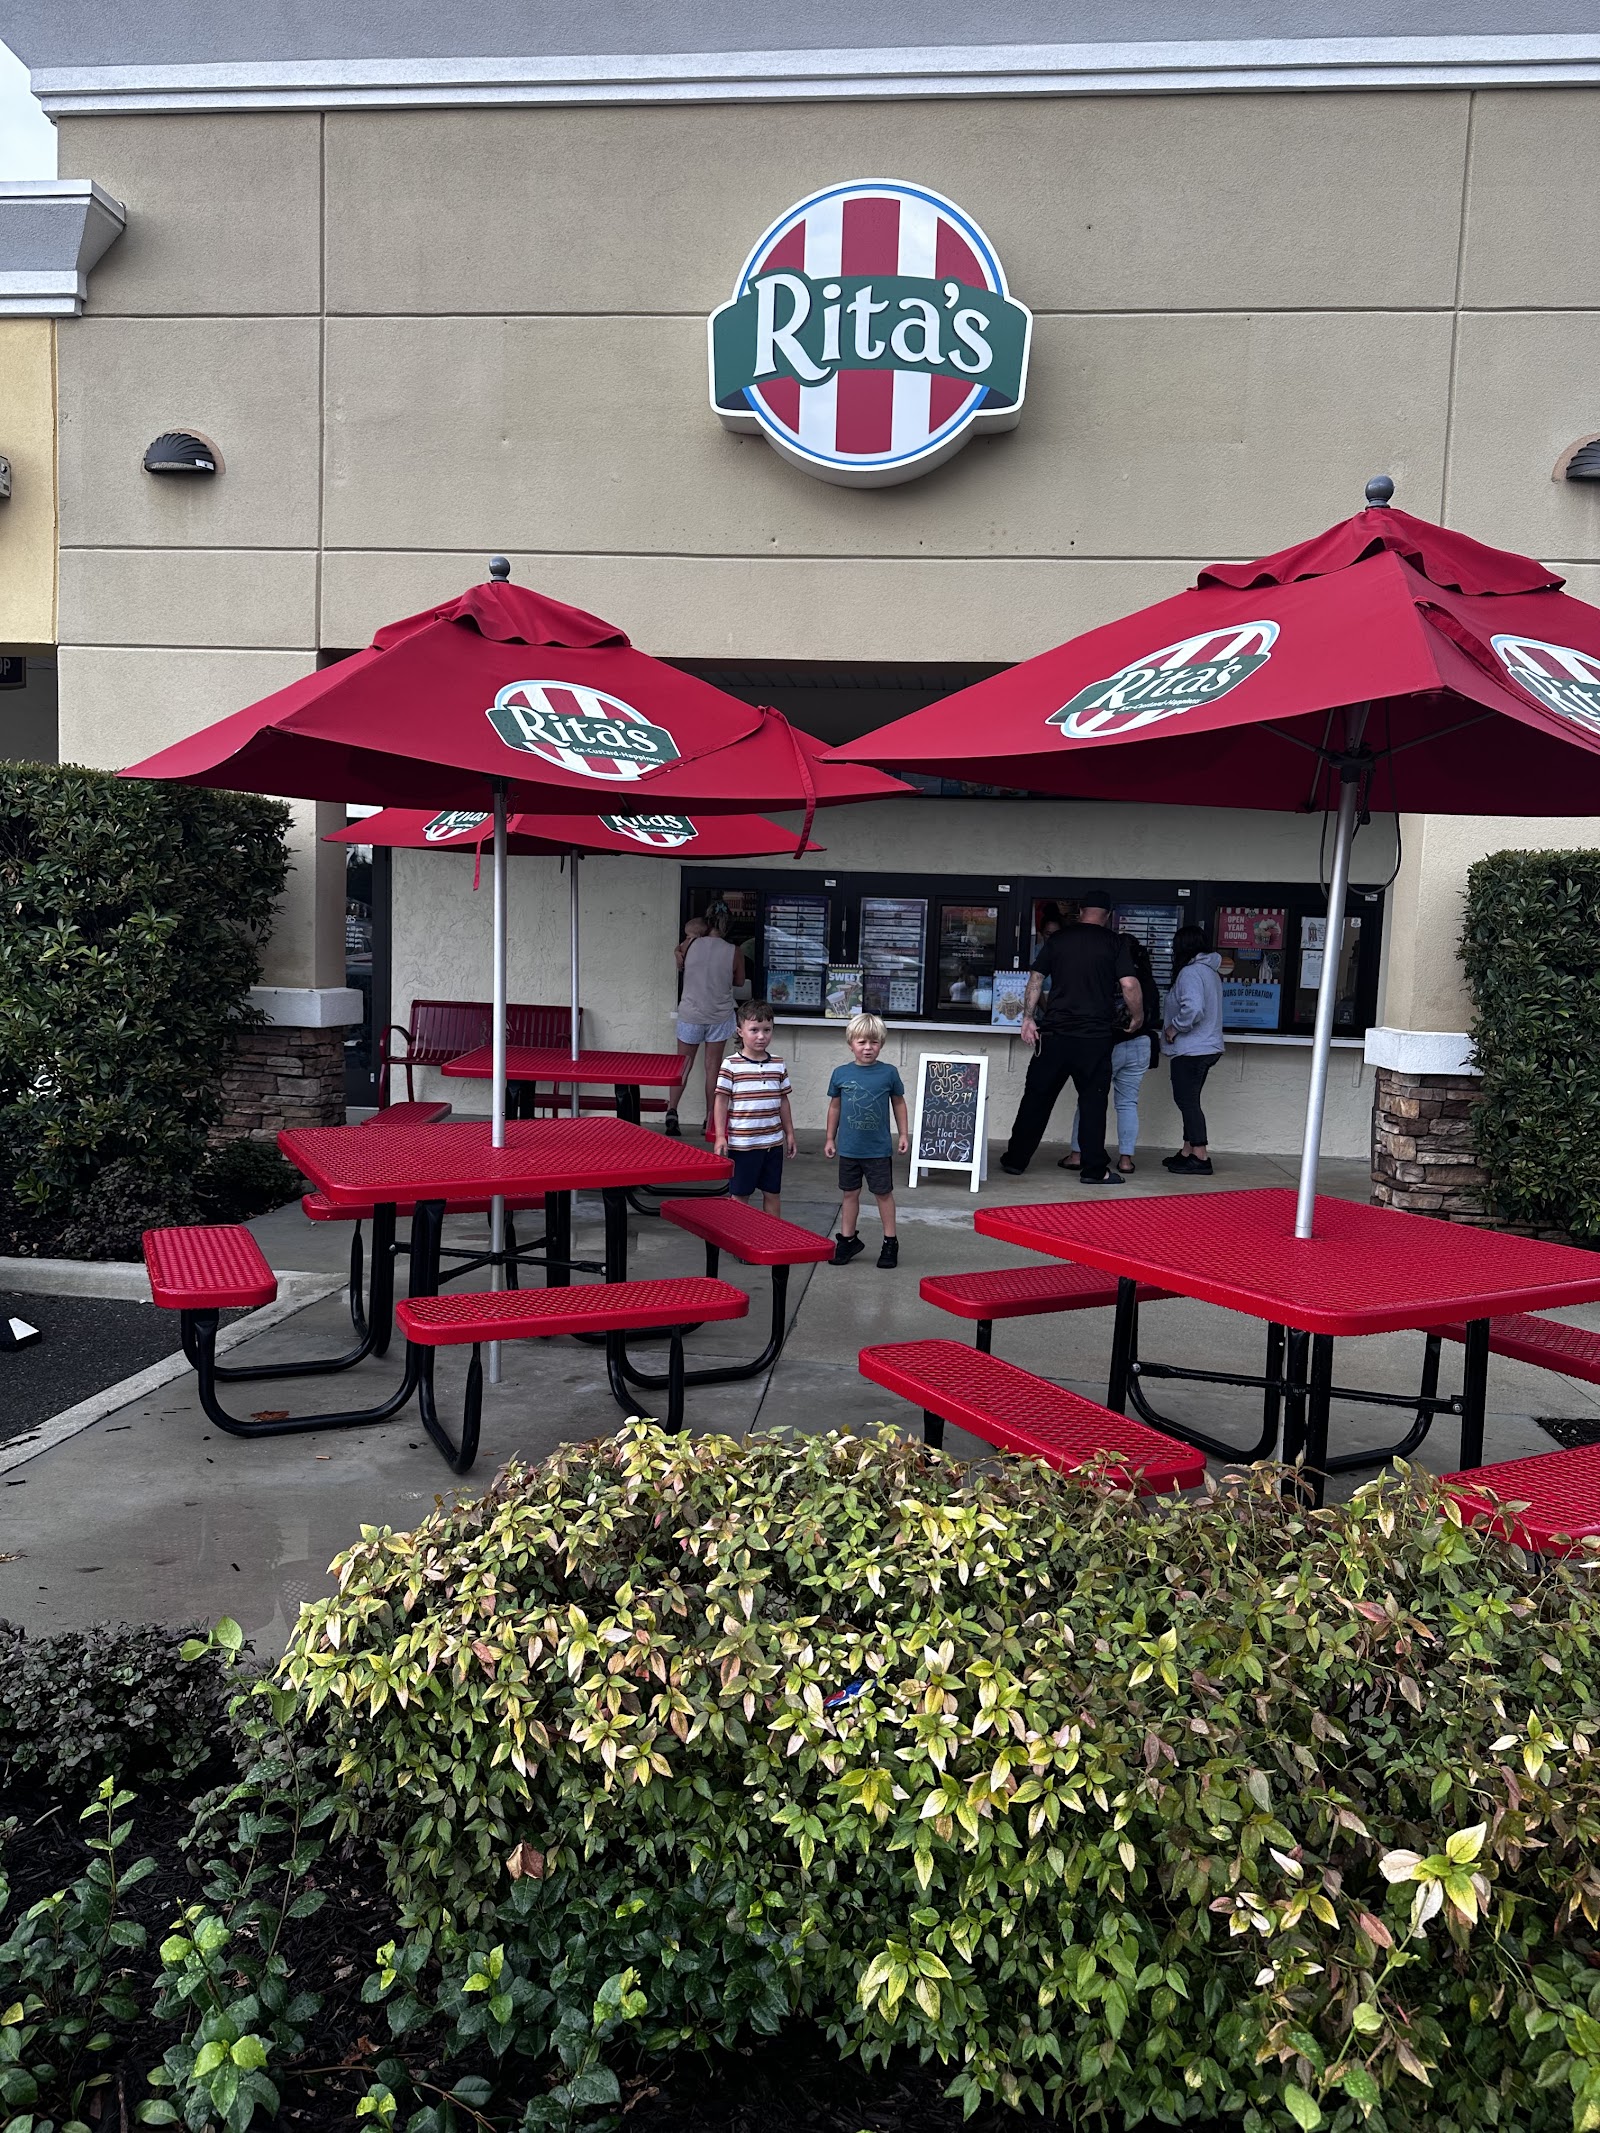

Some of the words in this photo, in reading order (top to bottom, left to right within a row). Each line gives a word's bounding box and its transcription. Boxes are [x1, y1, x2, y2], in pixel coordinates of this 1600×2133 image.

[753, 273, 993, 381] Rita's
[1084, 656, 1242, 709] Rita's
[507, 705, 658, 753] Rita's
[1228, 916, 1245, 924] OPEN
[1228, 924, 1247, 932] YEAR-
[1224, 931, 1248, 940] ROUND
[829, 972, 861, 982] SWEET
[1245, 989, 1274, 999] OPERATION
[929, 1062, 952, 1079] PUP
[930, 1073, 963, 1097] CUPS
[926, 1113, 948, 1128] ROOT
[951, 1115, 973, 1131] BEER
[937, 1128, 957, 1139] float
